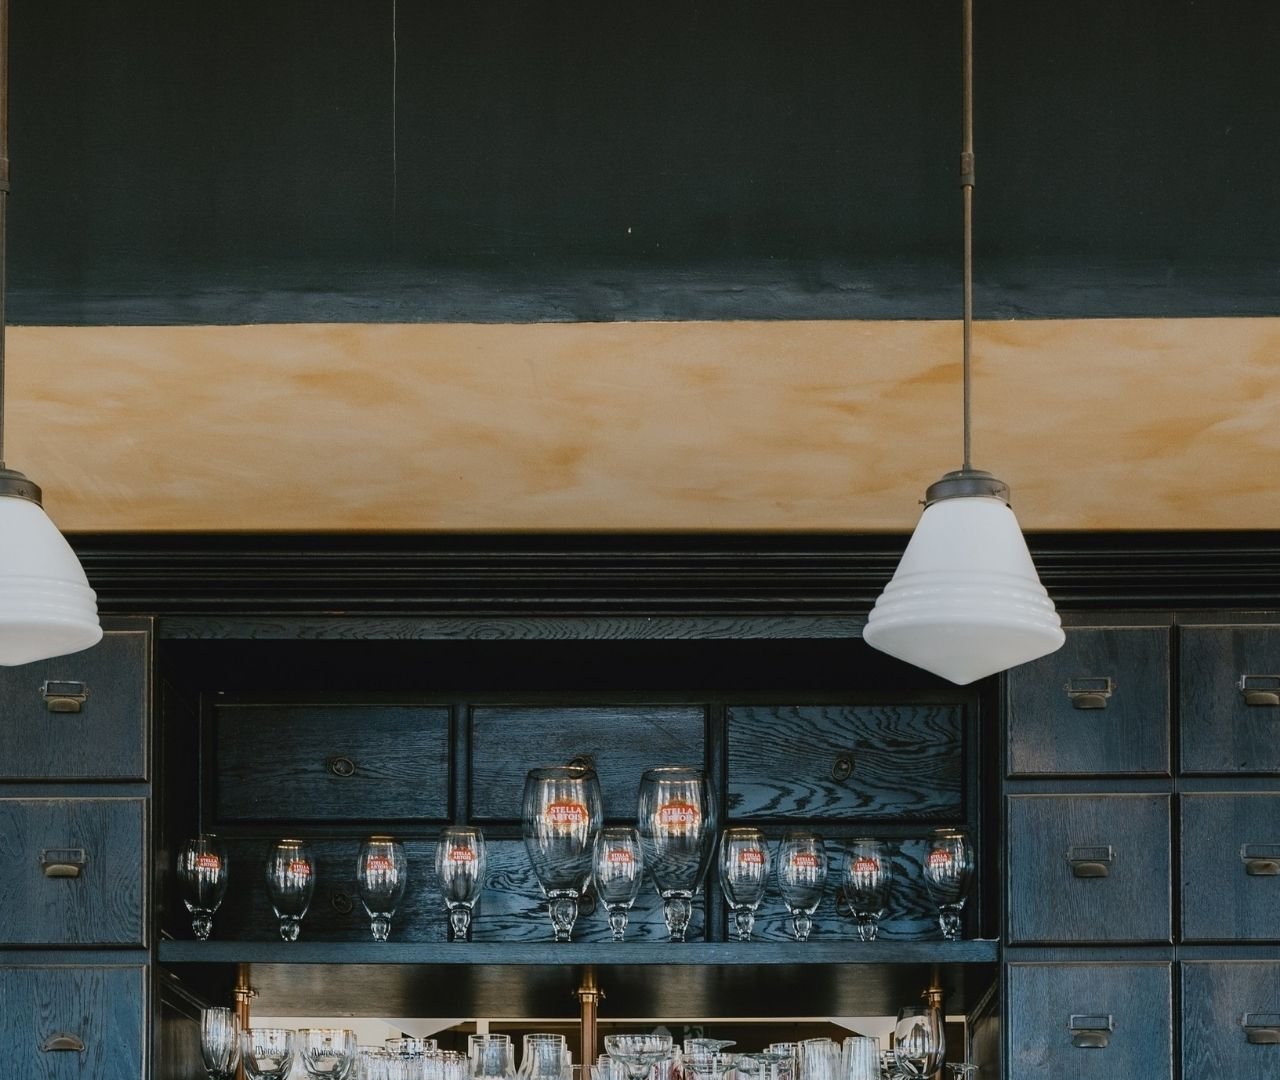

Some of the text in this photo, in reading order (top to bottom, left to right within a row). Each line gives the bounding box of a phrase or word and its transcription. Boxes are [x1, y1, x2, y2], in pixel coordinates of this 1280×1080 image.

[550, 806, 581, 814] STELLA
[662, 807, 693, 815] STELLA
[550, 813, 583, 821] ARTOIS
